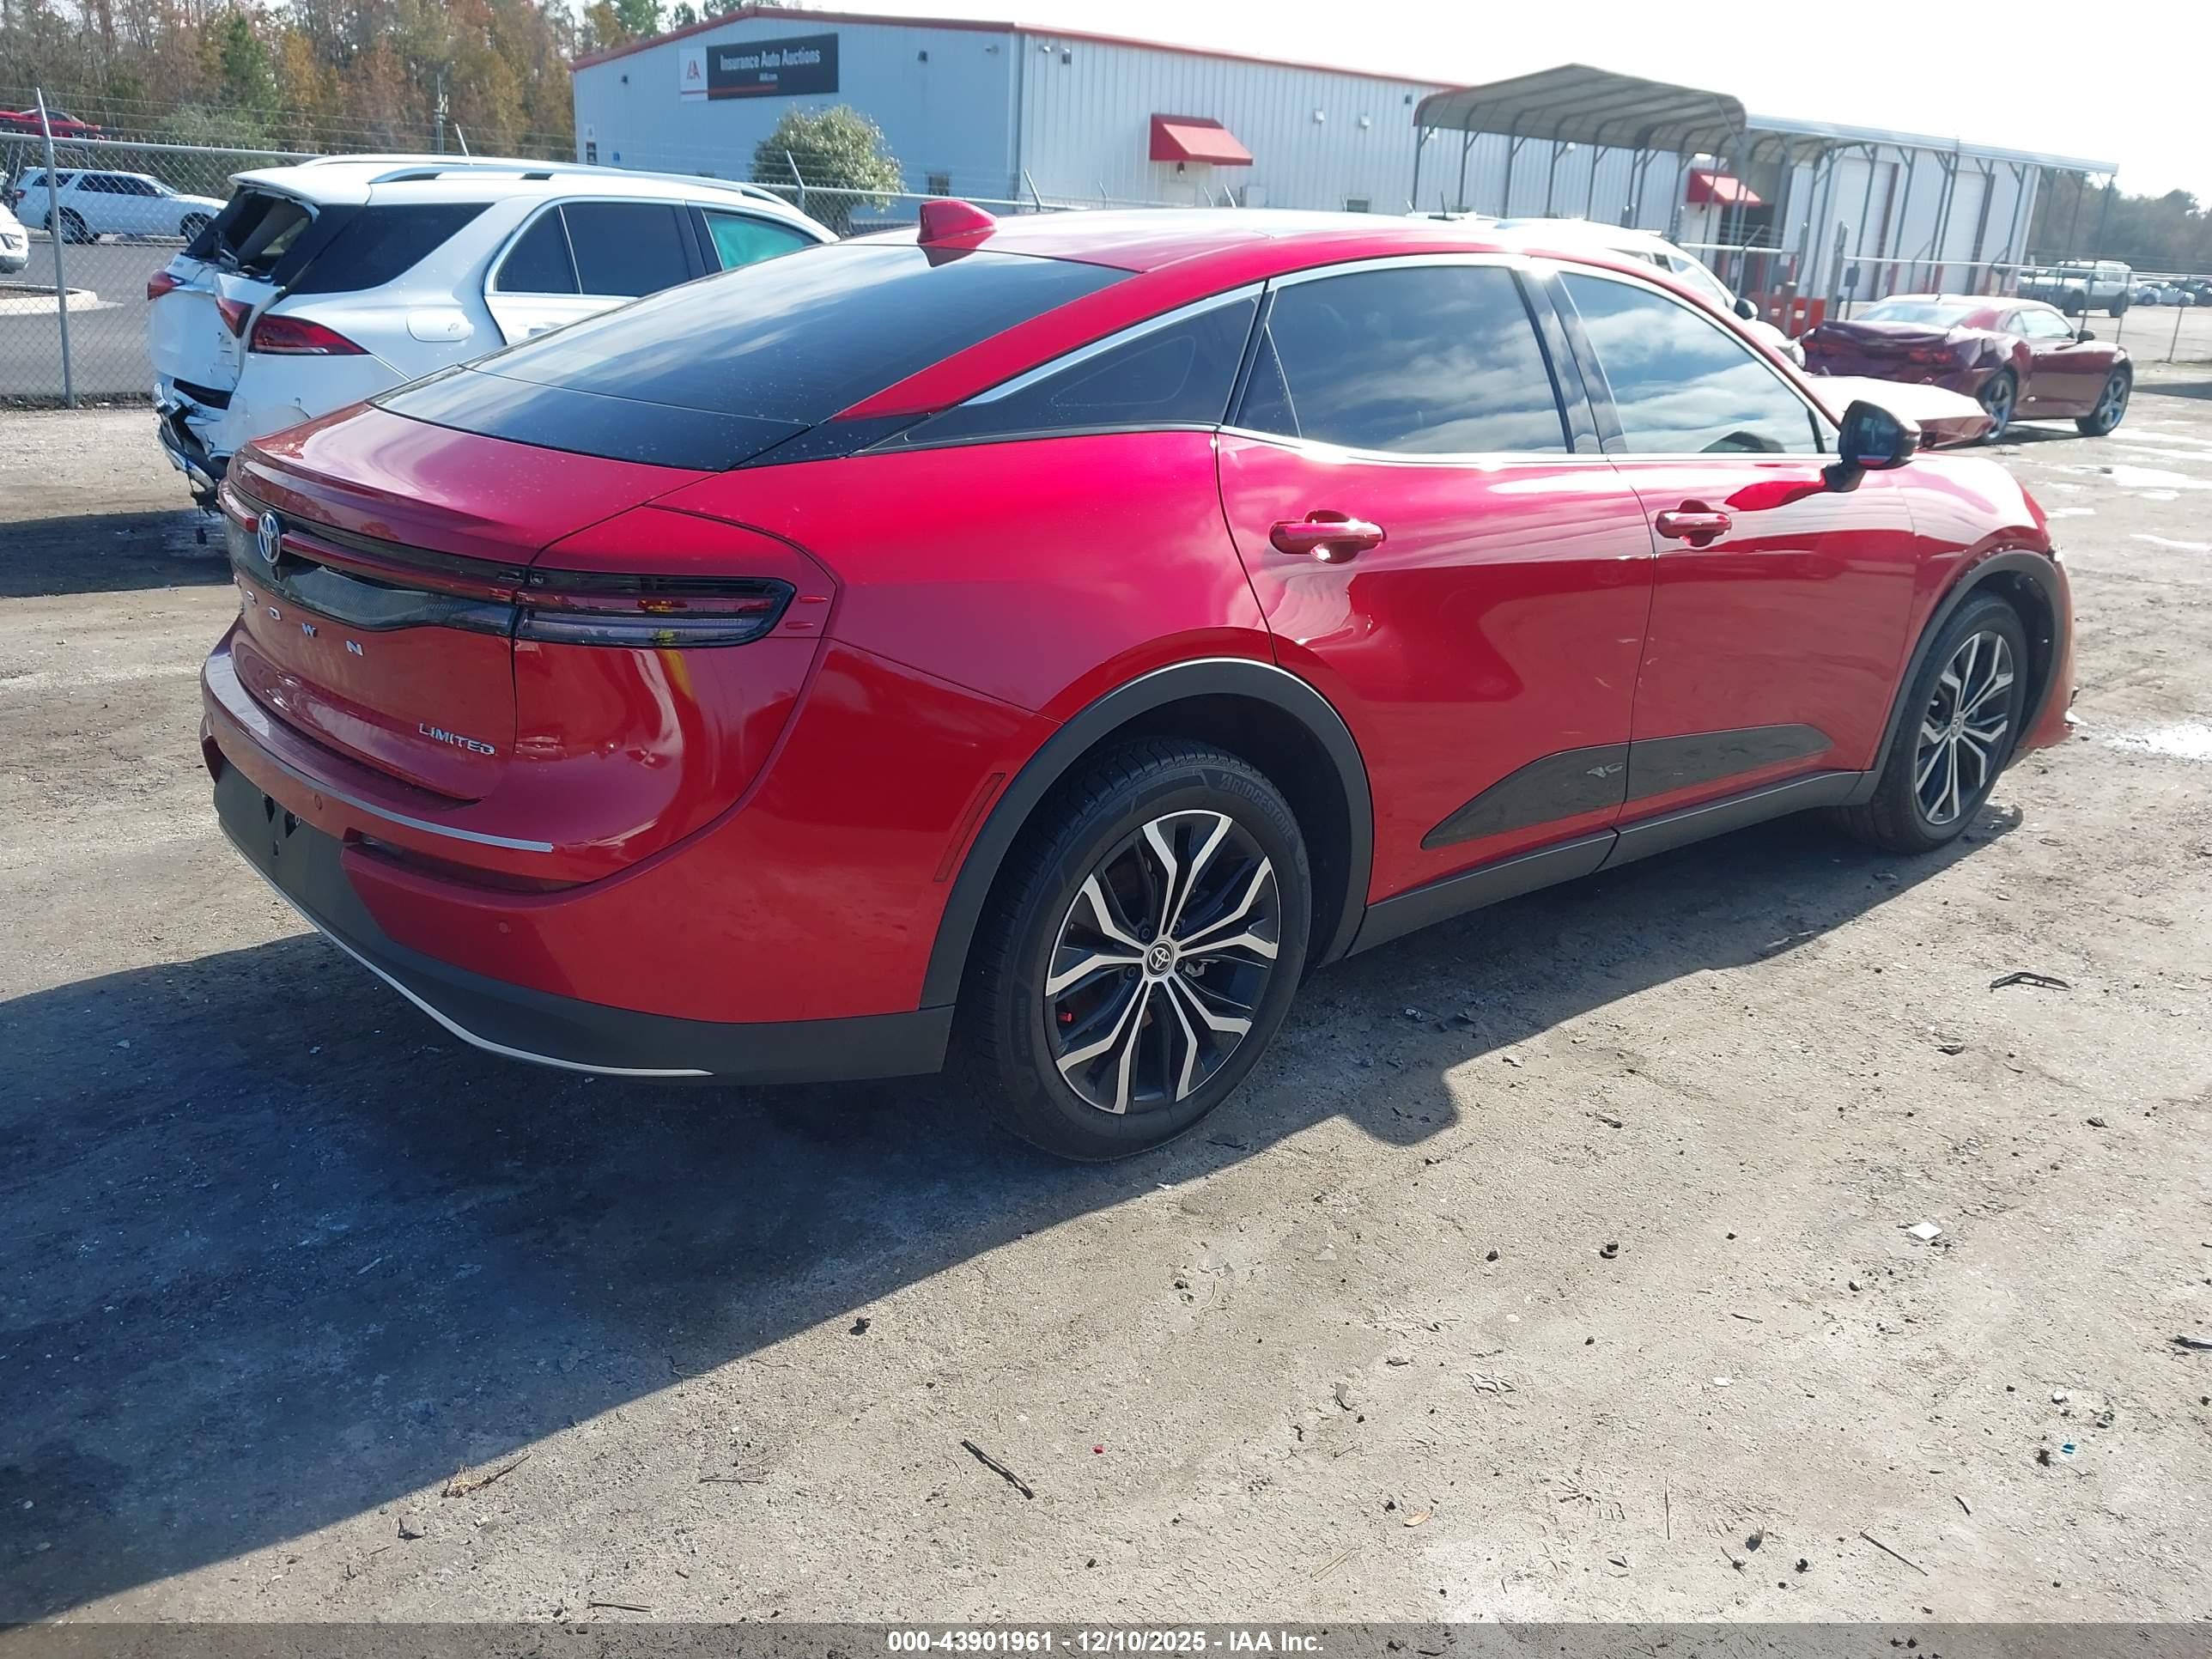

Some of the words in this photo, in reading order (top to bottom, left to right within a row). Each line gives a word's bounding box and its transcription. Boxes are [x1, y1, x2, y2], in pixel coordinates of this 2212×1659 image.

[720, 54, 760, 71] Insurance
[761, 50, 781, 68] Auto
[781, 46, 821, 66] Auctions
[418, 722, 495, 756] LIMITED
[1219, 772, 1296, 842] BRIDGESTONE
